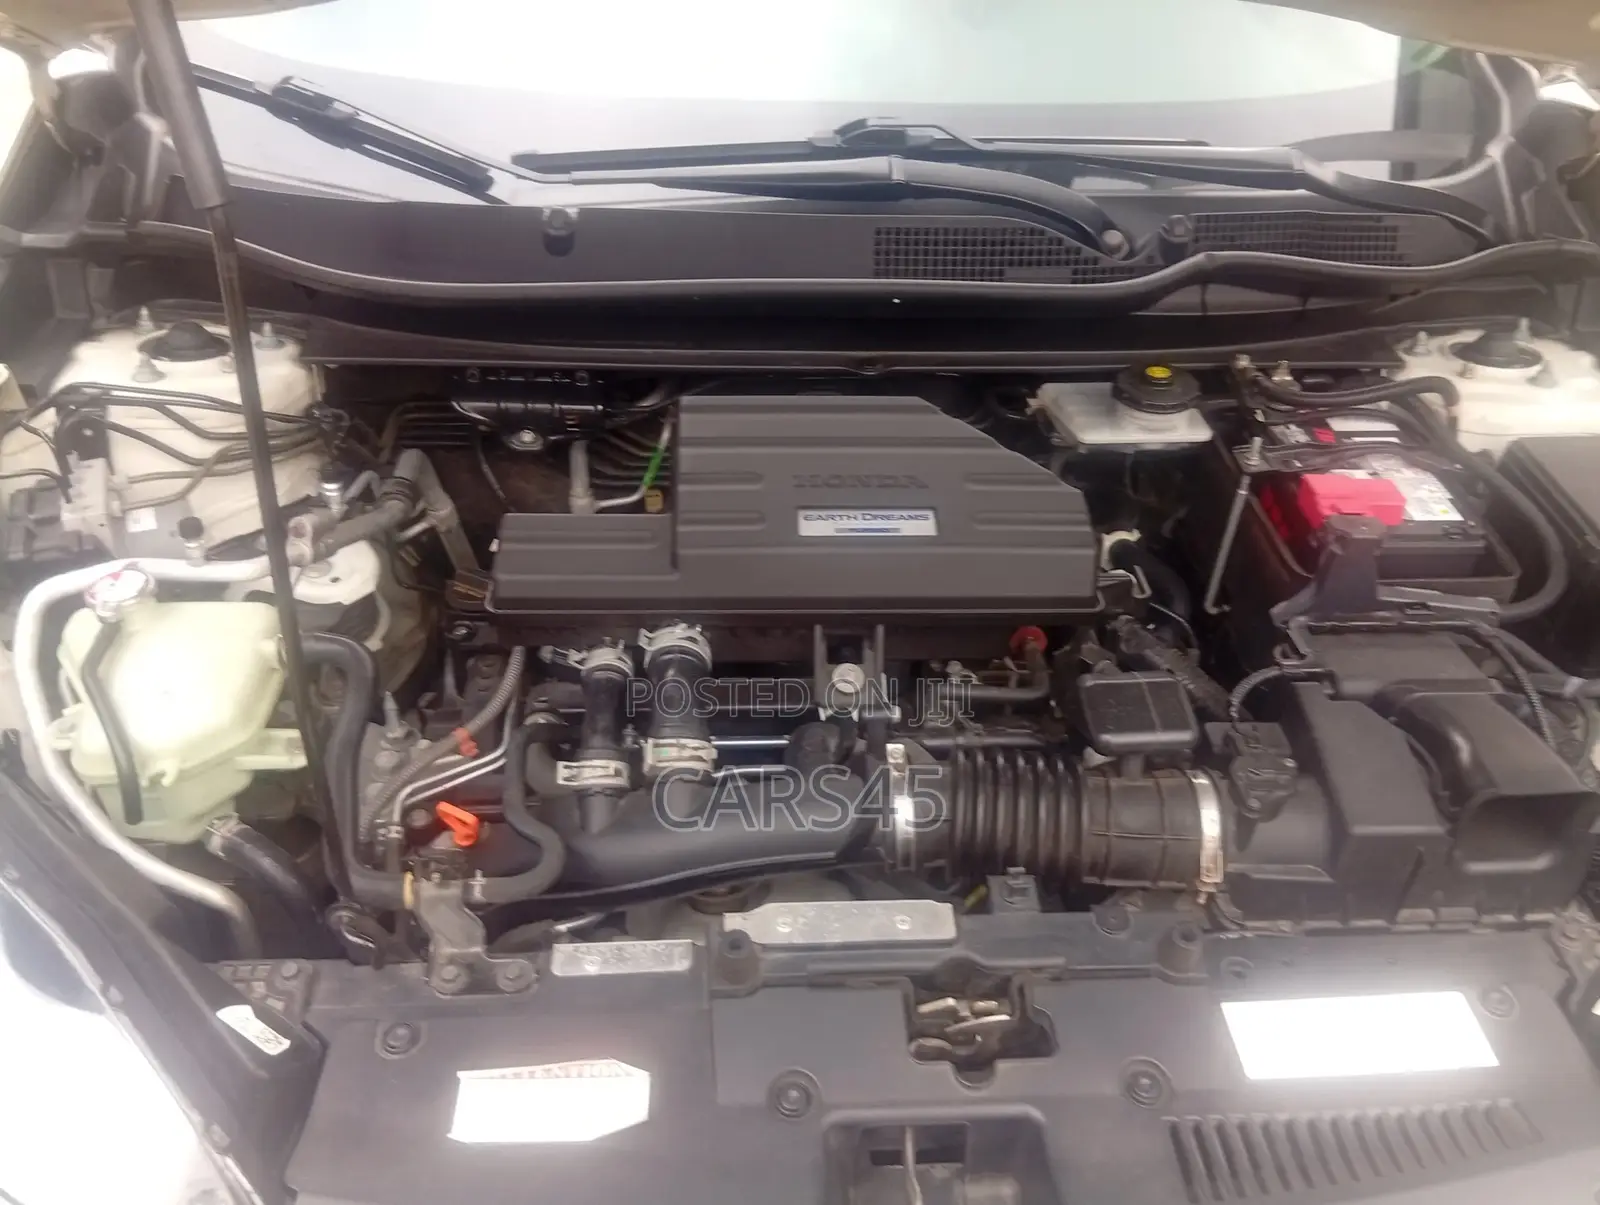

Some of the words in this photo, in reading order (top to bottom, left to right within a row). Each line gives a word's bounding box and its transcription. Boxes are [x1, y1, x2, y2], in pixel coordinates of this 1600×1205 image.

[791, 473, 930, 489] HONDA
[803, 514, 858, 522] EARTH
[861, 513, 931, 522] DREAMS
